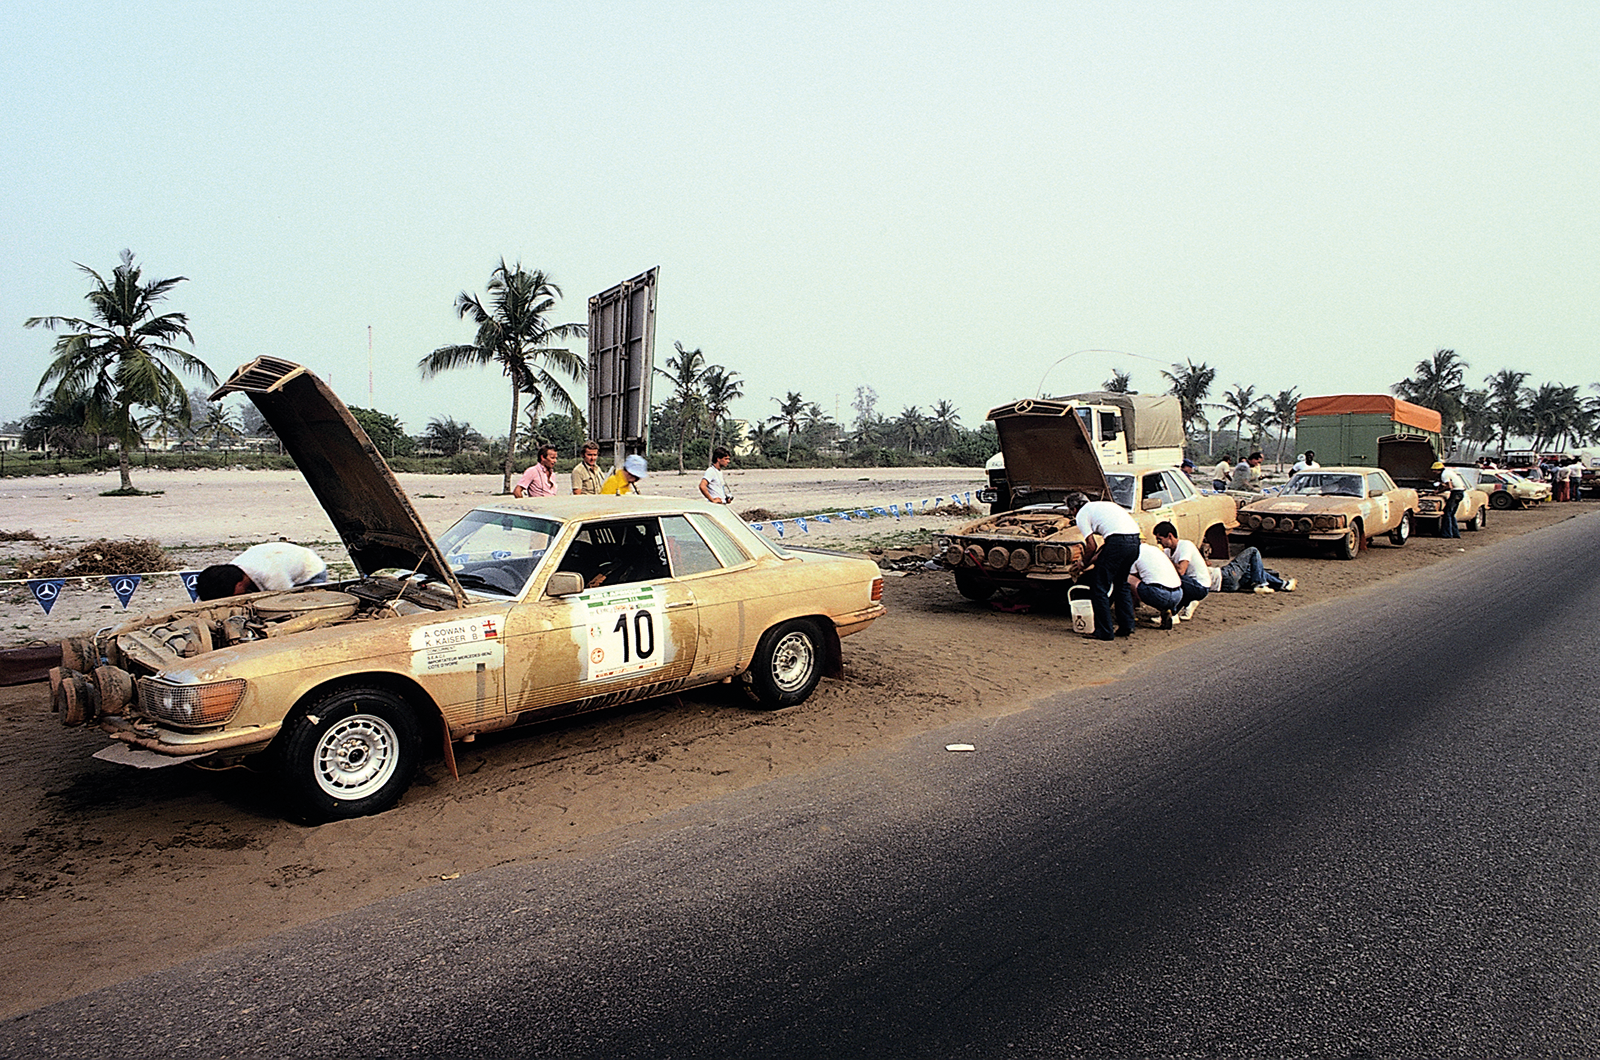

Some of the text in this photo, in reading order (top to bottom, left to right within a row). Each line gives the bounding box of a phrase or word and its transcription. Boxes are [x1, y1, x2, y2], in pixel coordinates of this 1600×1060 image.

[434, 627, 465, 637] COWAN
[613, 610, 654, 663] 10
[436, 635, 465, 644] KAISER
[427, 651, 492, 664] IMPORTATEUR MERCEDES-BENZ
